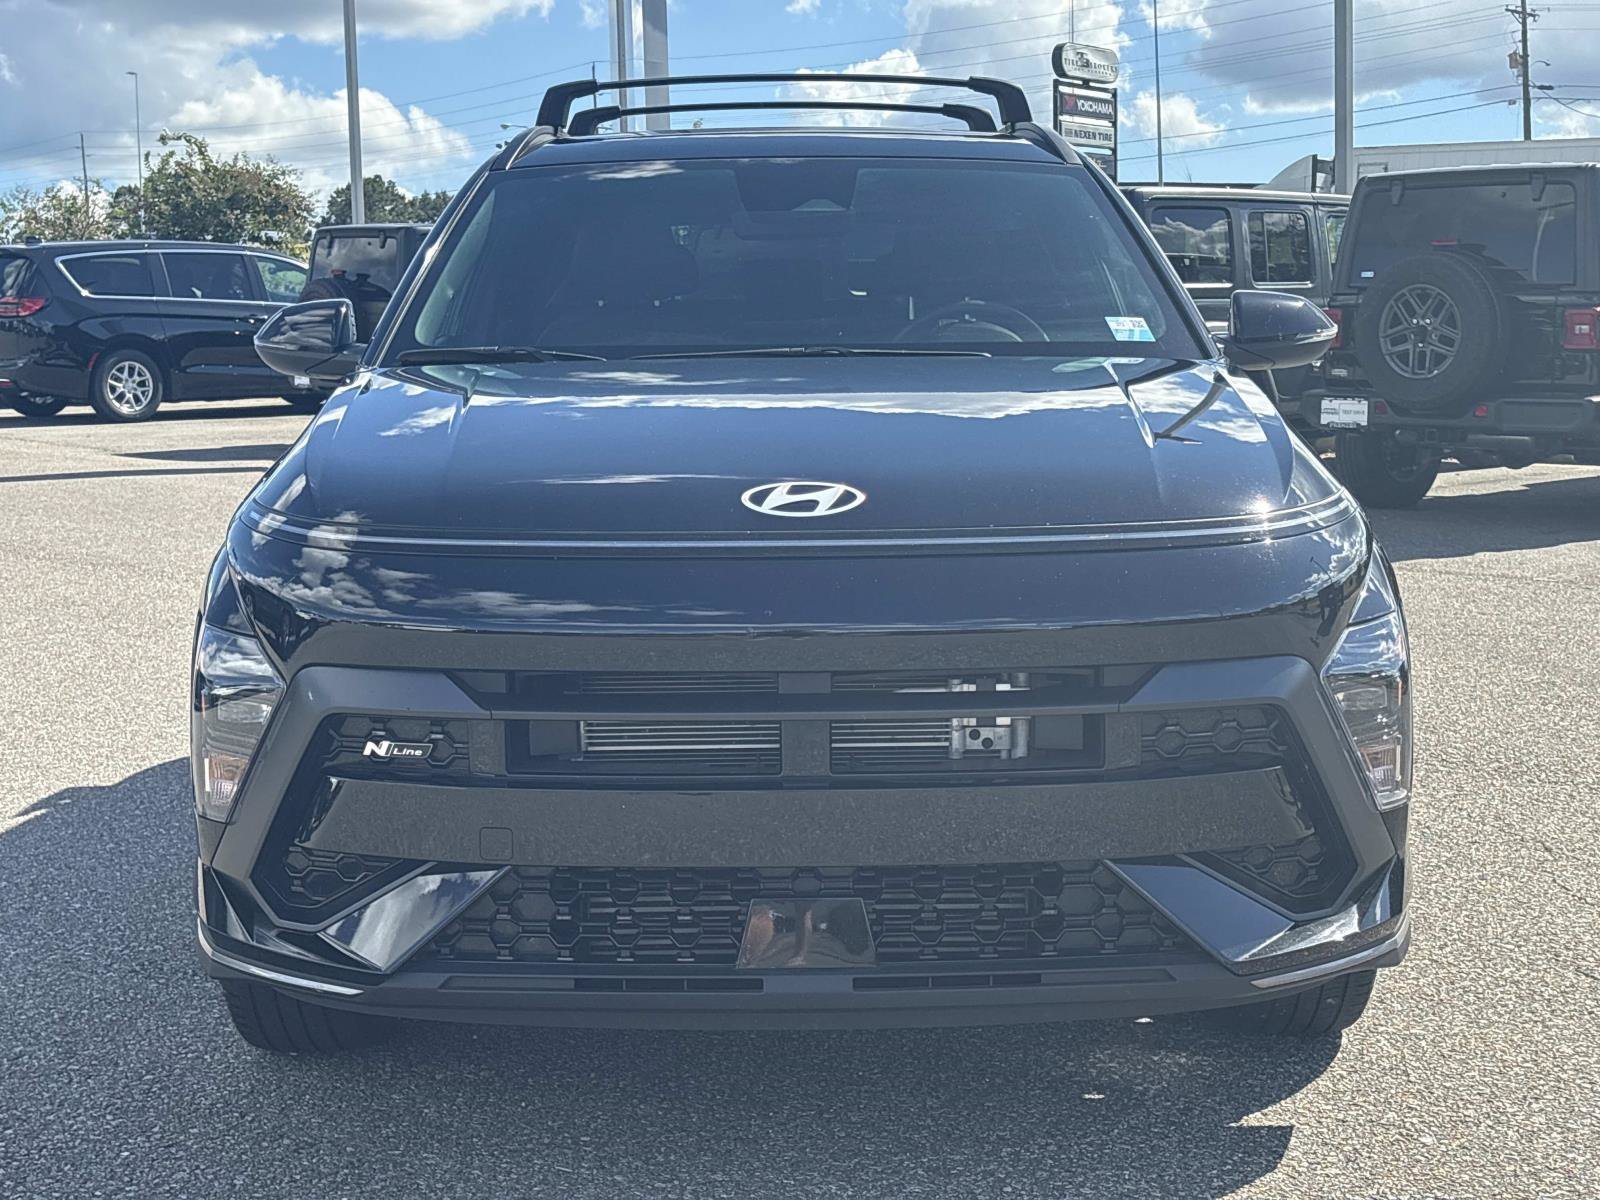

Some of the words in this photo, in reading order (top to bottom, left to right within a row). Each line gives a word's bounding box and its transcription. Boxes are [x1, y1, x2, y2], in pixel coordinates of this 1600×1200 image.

[1076, 99, 1113, 115] YOKOHAMA
[1073, 129, 1096, 141] NEXEN
[1098, 131, 1113, 142] TIRE
[362, 740, 391, 757] N
[393, 747, 423, 756] Line
